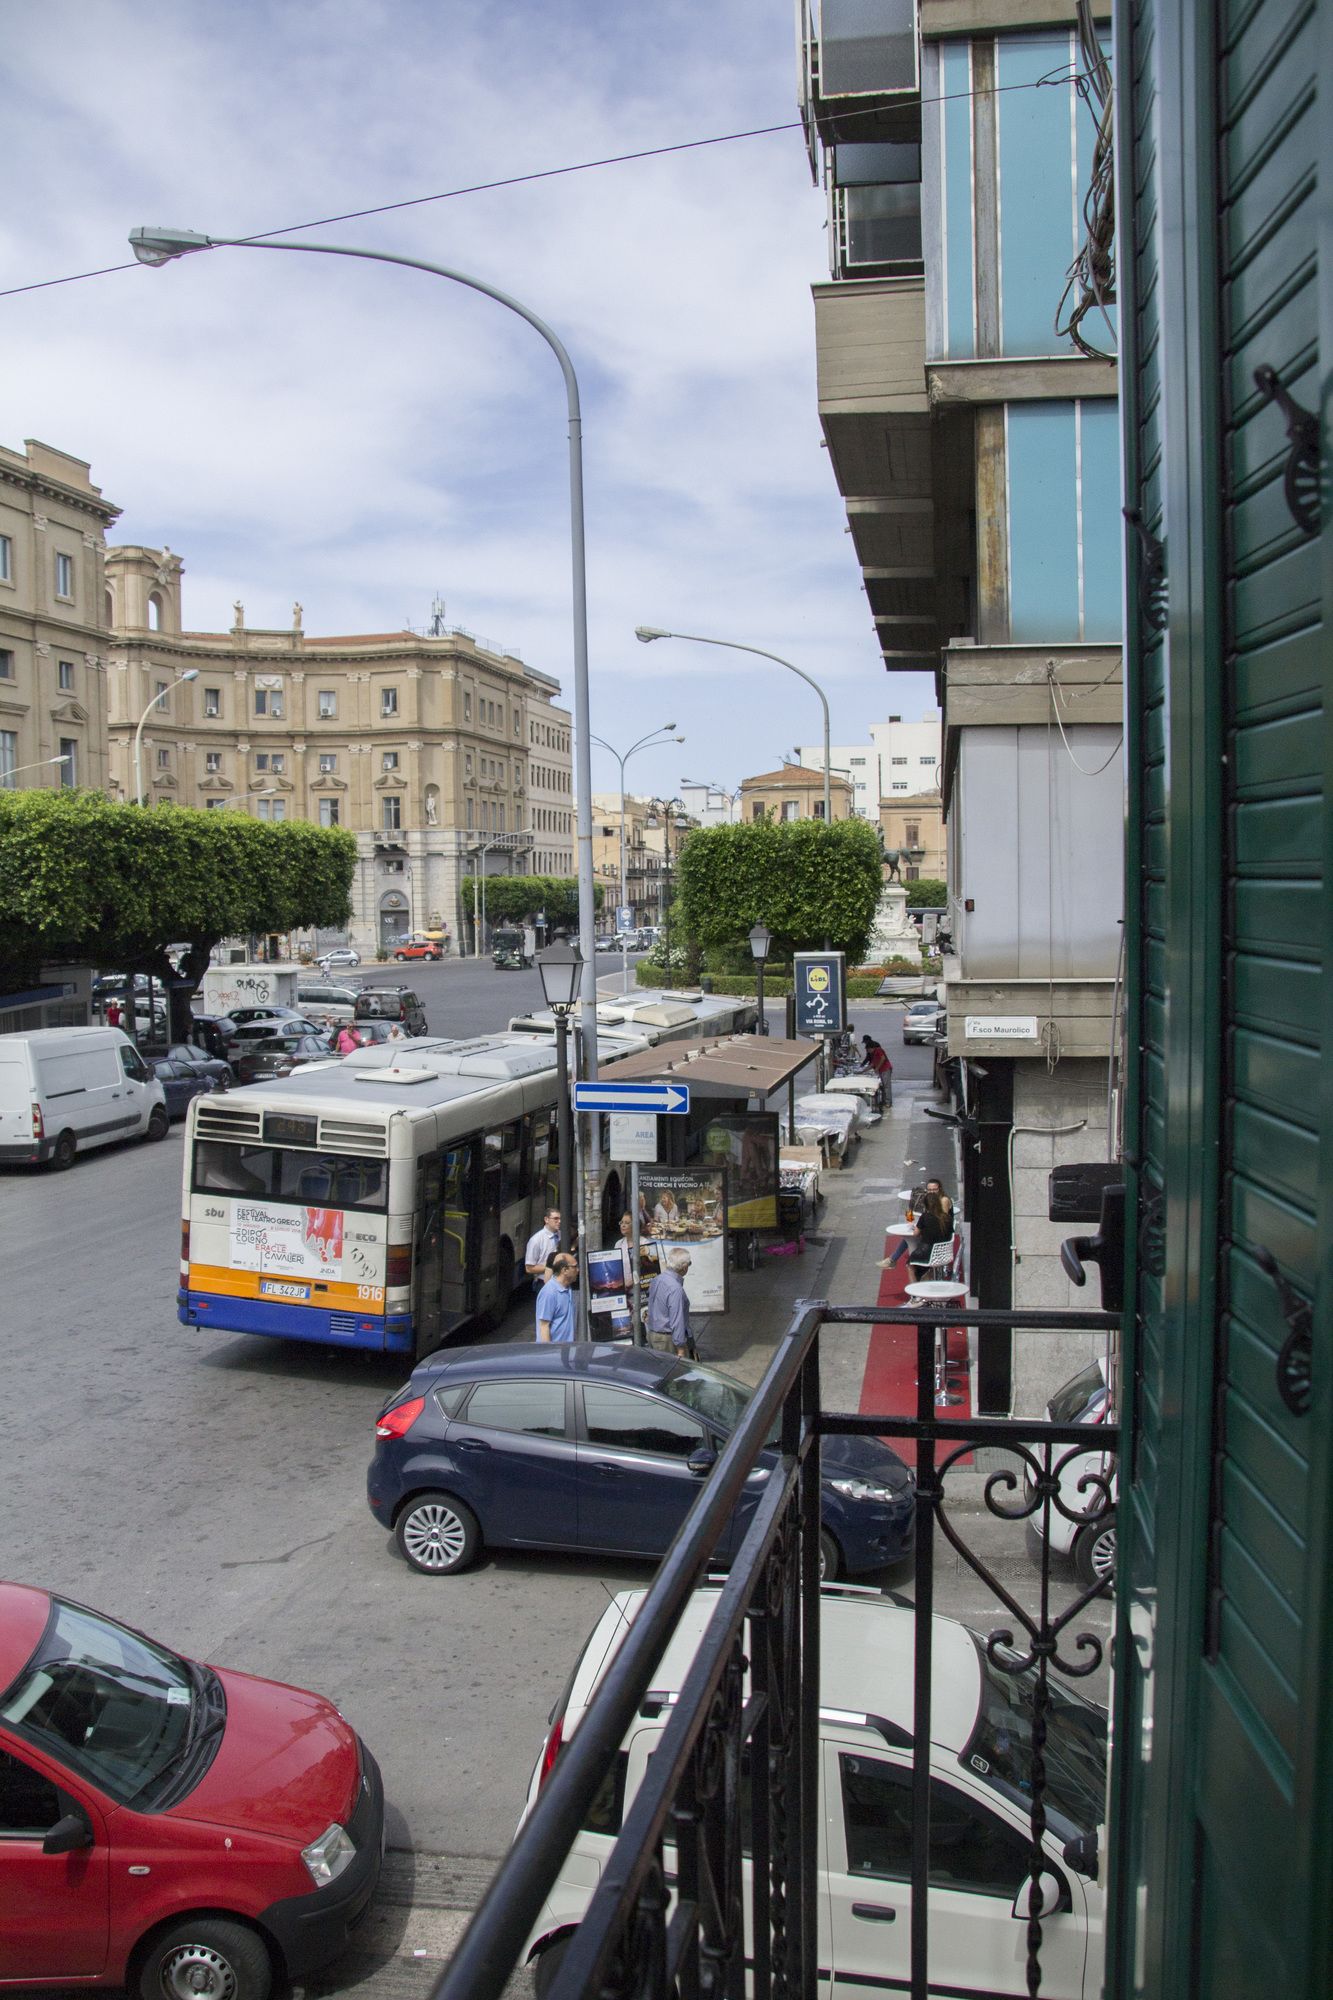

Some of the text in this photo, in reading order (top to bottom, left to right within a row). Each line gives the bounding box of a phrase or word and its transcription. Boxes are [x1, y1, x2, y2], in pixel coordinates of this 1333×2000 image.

[634, 1131, 654, 1139] AREA
[981, 1176, 994, 1187] 45
[204, 1207, 226, 1219] sbu
[237, 1208, 268, 1217] FESTIVAL
[236, 1213, 301, 1226] DEL TEATRO GRECO
[344, 1231, 377, 1242] IECO
[255, 1244, 287, 1253] ERACLE
[266, 1283, 277, 1294] FL
[356, 1284, 383, 1301] 1916
